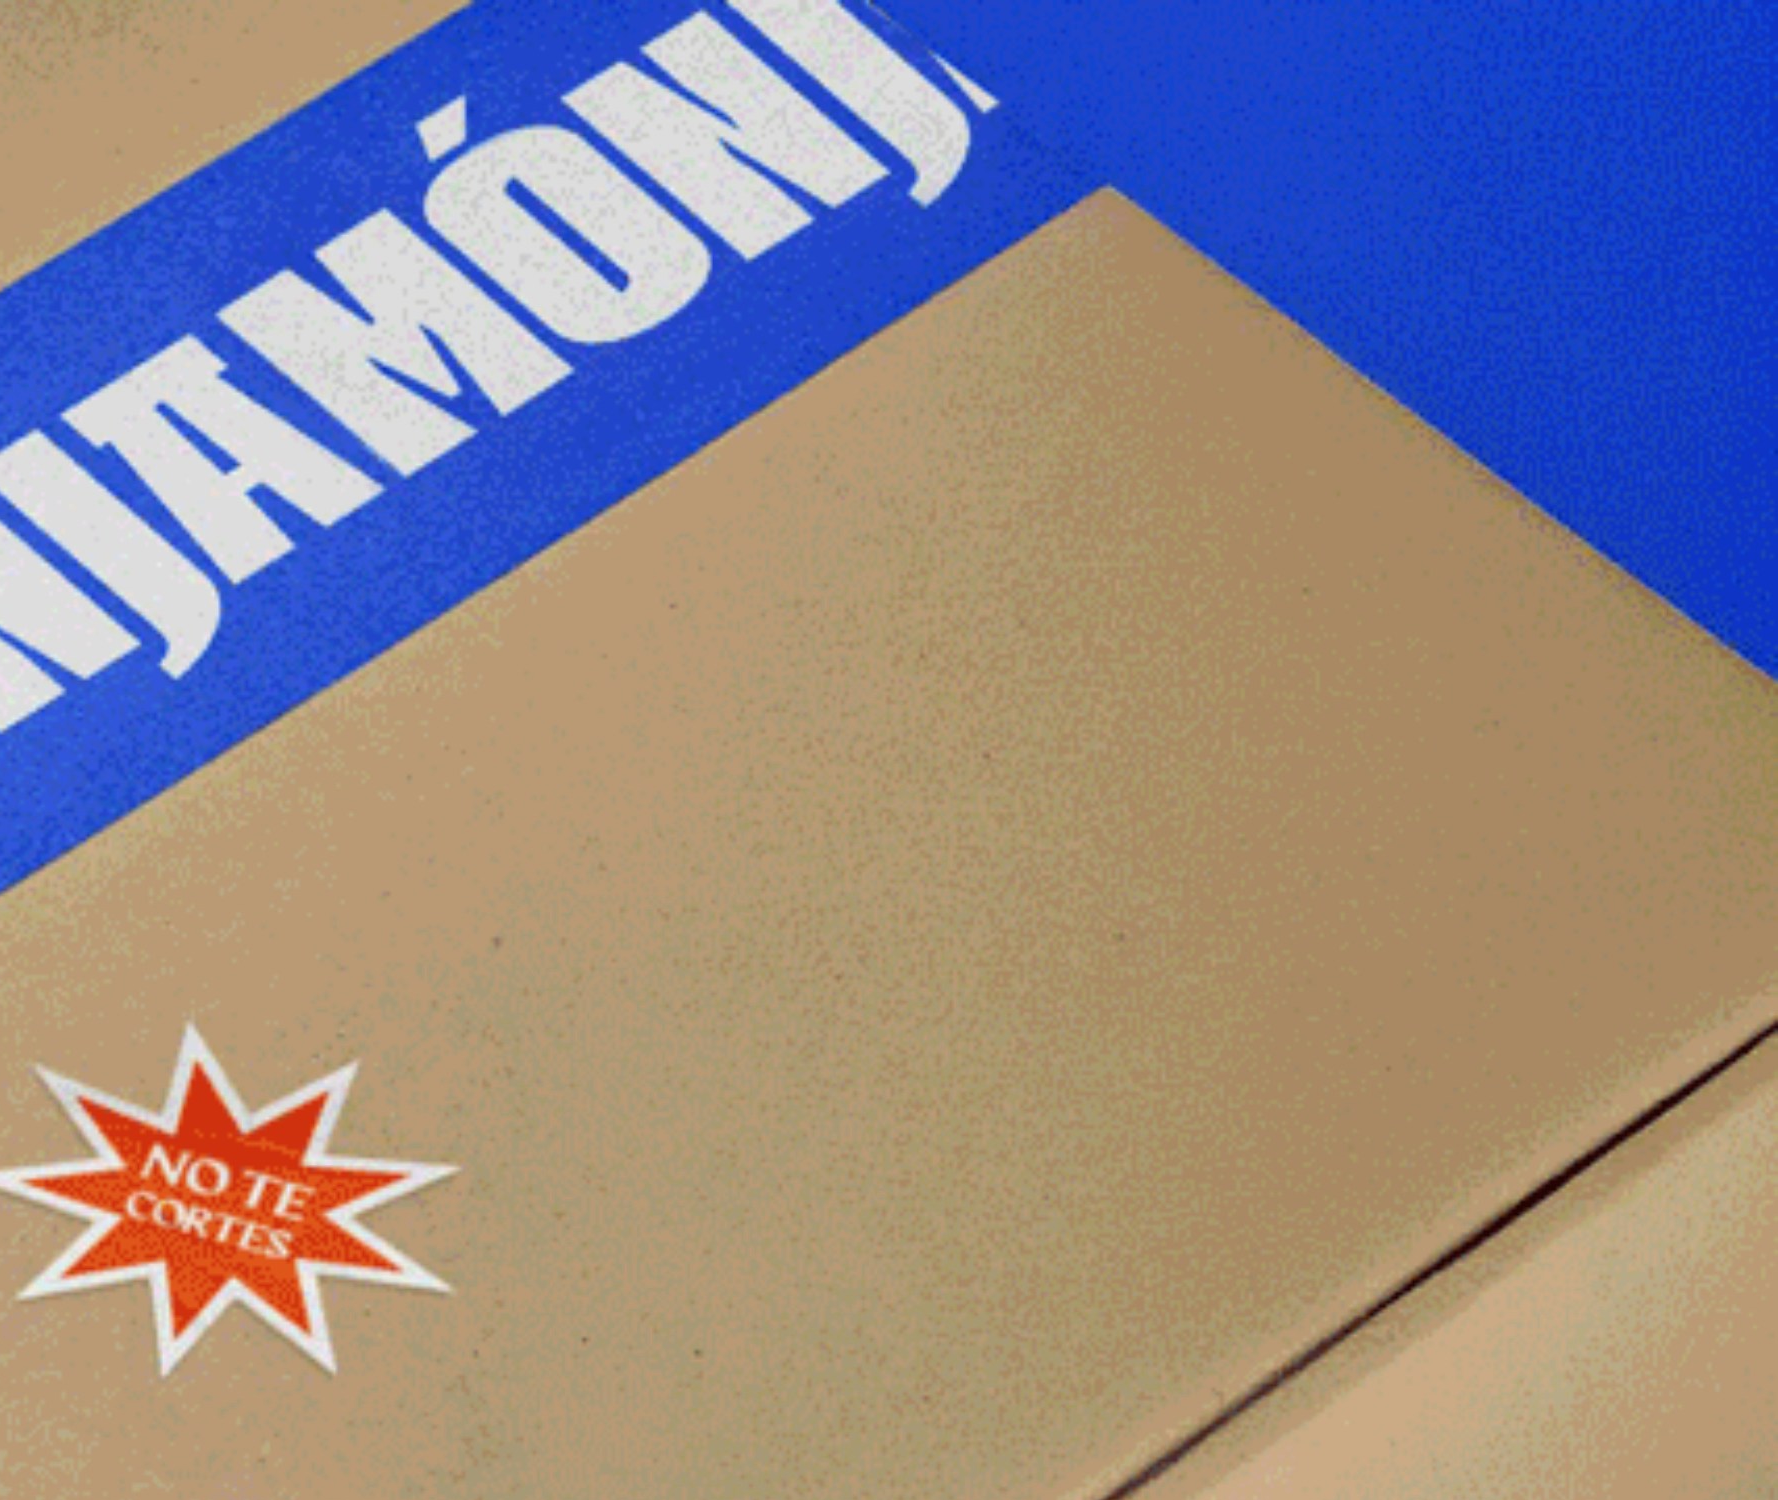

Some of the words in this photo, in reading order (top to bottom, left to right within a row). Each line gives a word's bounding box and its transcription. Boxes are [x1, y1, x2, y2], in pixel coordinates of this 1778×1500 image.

[140, 1143, 231, 1195] NO
[244, 1169, 316, 1222] TE
[126, 1190, 294, 1259] CORTES
